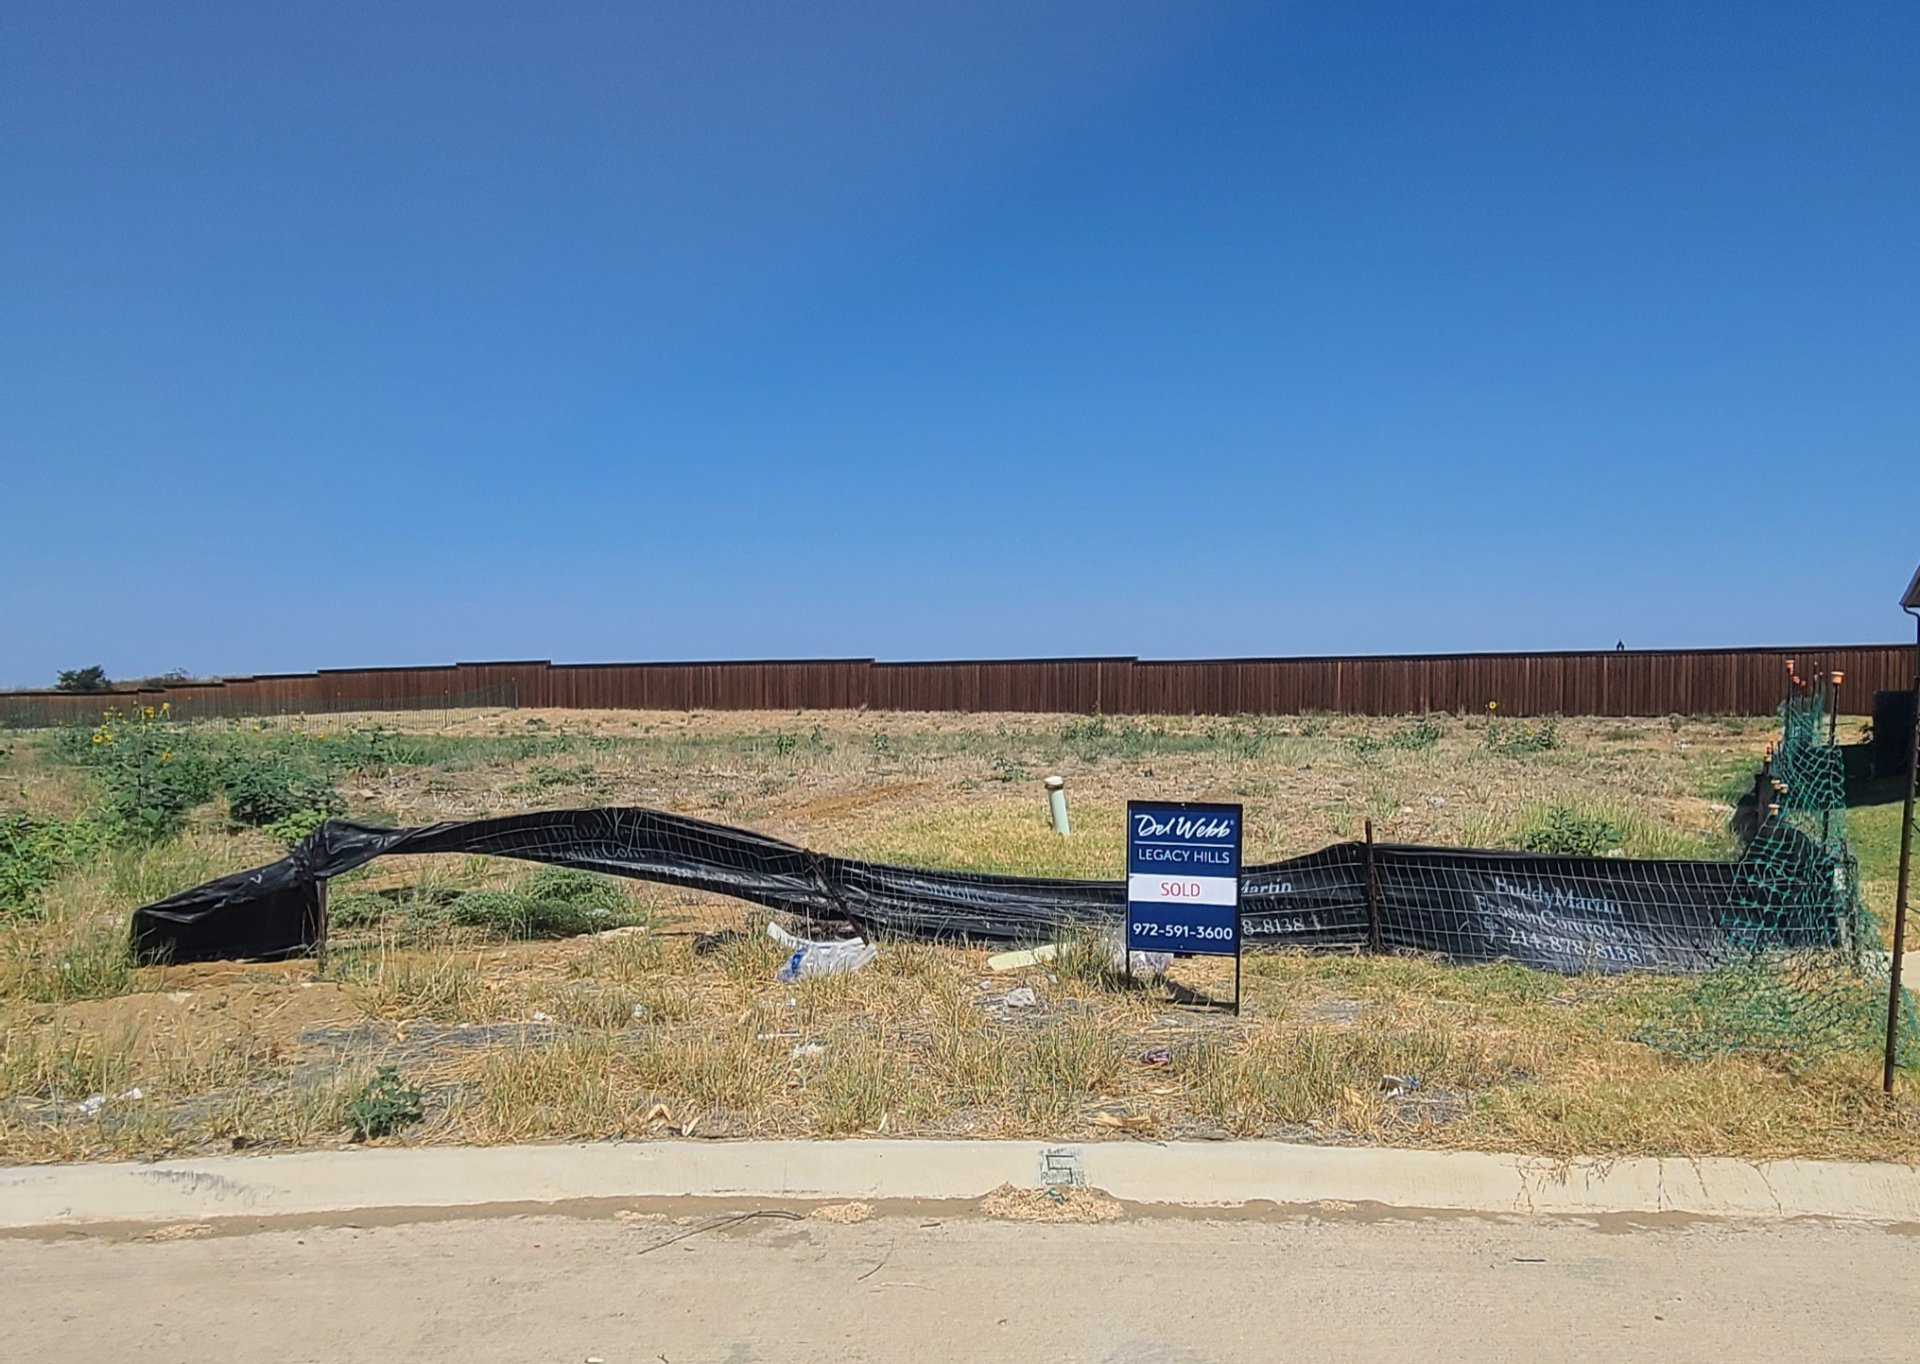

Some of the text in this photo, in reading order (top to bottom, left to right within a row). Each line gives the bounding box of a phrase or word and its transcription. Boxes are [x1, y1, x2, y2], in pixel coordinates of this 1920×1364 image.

[1134, 814, 1231, 839] Del Webb
[1138, 848, 1230, 864] LEGACY HILLS
[1161, 882, 1200, 897] SOLD
[1132, 922, 1233, 940] 972-591-3600
[1241, 917, 1305, 935] 8-8138
